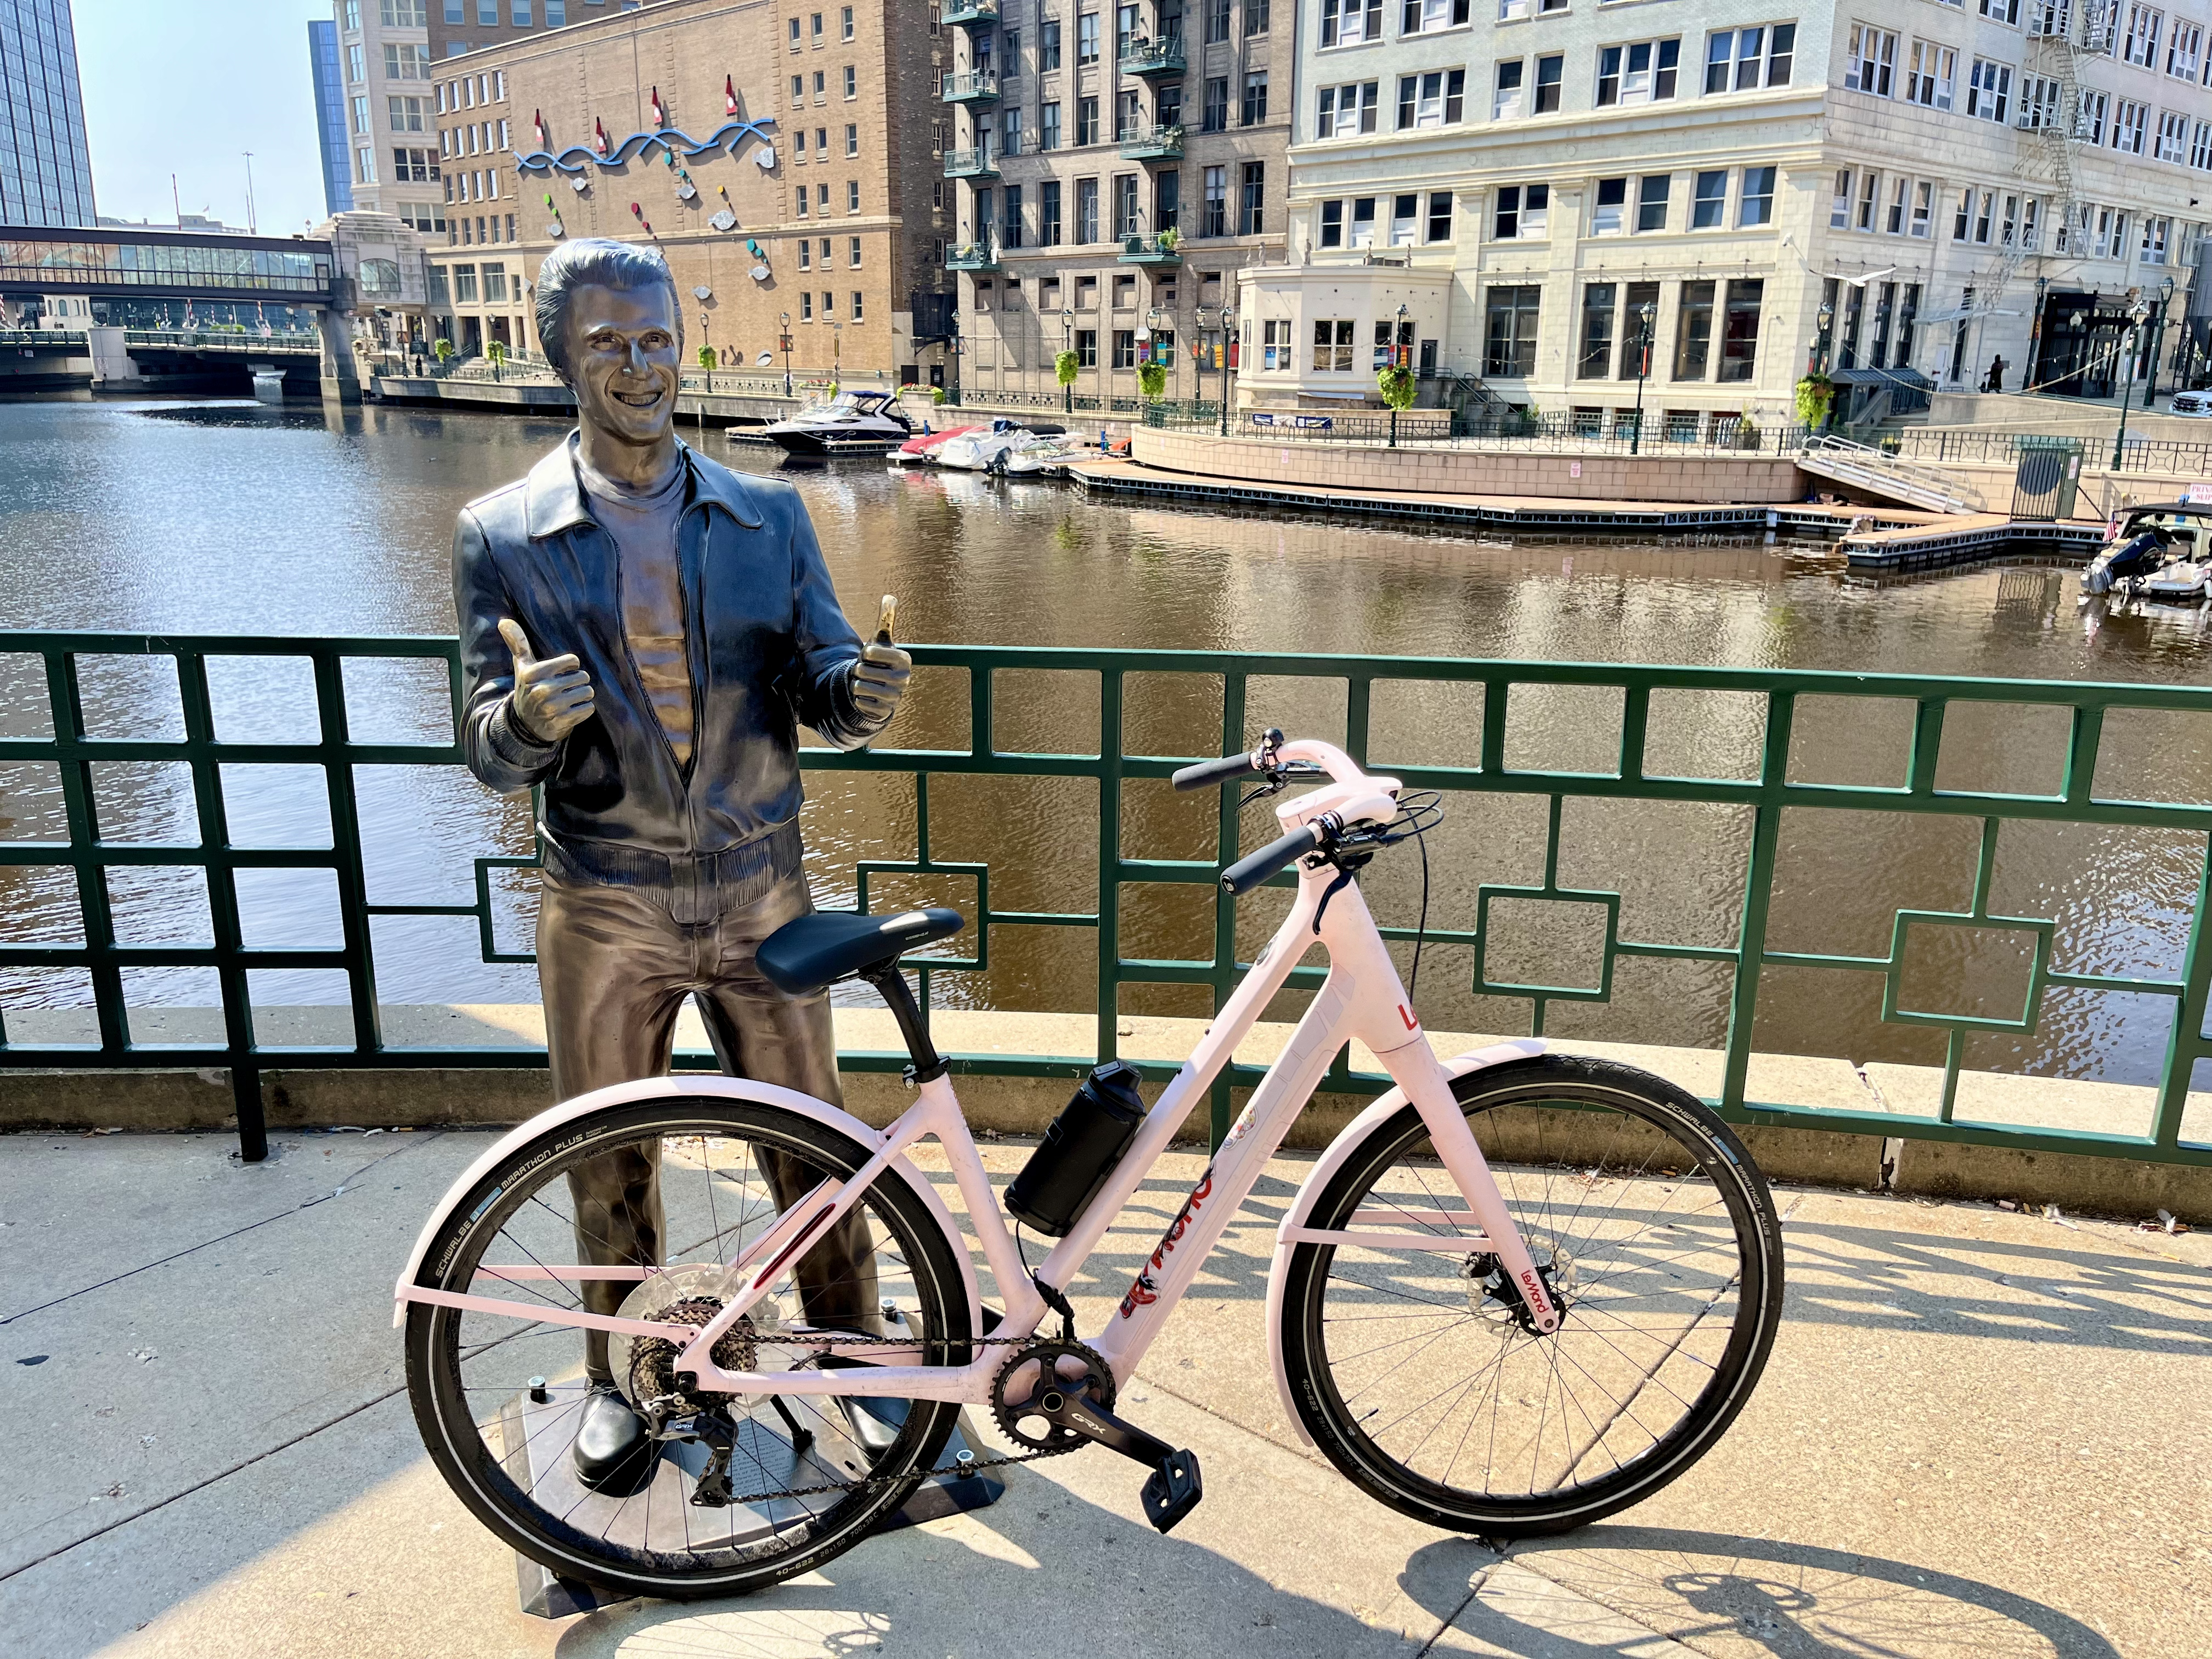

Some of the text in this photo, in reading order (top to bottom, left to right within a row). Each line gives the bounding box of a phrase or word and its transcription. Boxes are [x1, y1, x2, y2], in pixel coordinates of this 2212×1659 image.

[1665, 1102, 1714, 1137] SCHWALBE
[1735, 1164, 1763, 1209] MARATHON
[1758, 1211, 1771, 1236] PLUS
[435, 1220, 472, 1279] SCHWALBE
[500, 1149, 552, 1190] MARATHON
[555, 1133, 583, 1152] PLUS
[1521, 1269, 1550, 1313] LeMond
[1302, 1378, 1319, 1412] 40-622
[1071, 1413, 1107, 1434] GRX
[775, 1556, 815, 1577] 40-622
